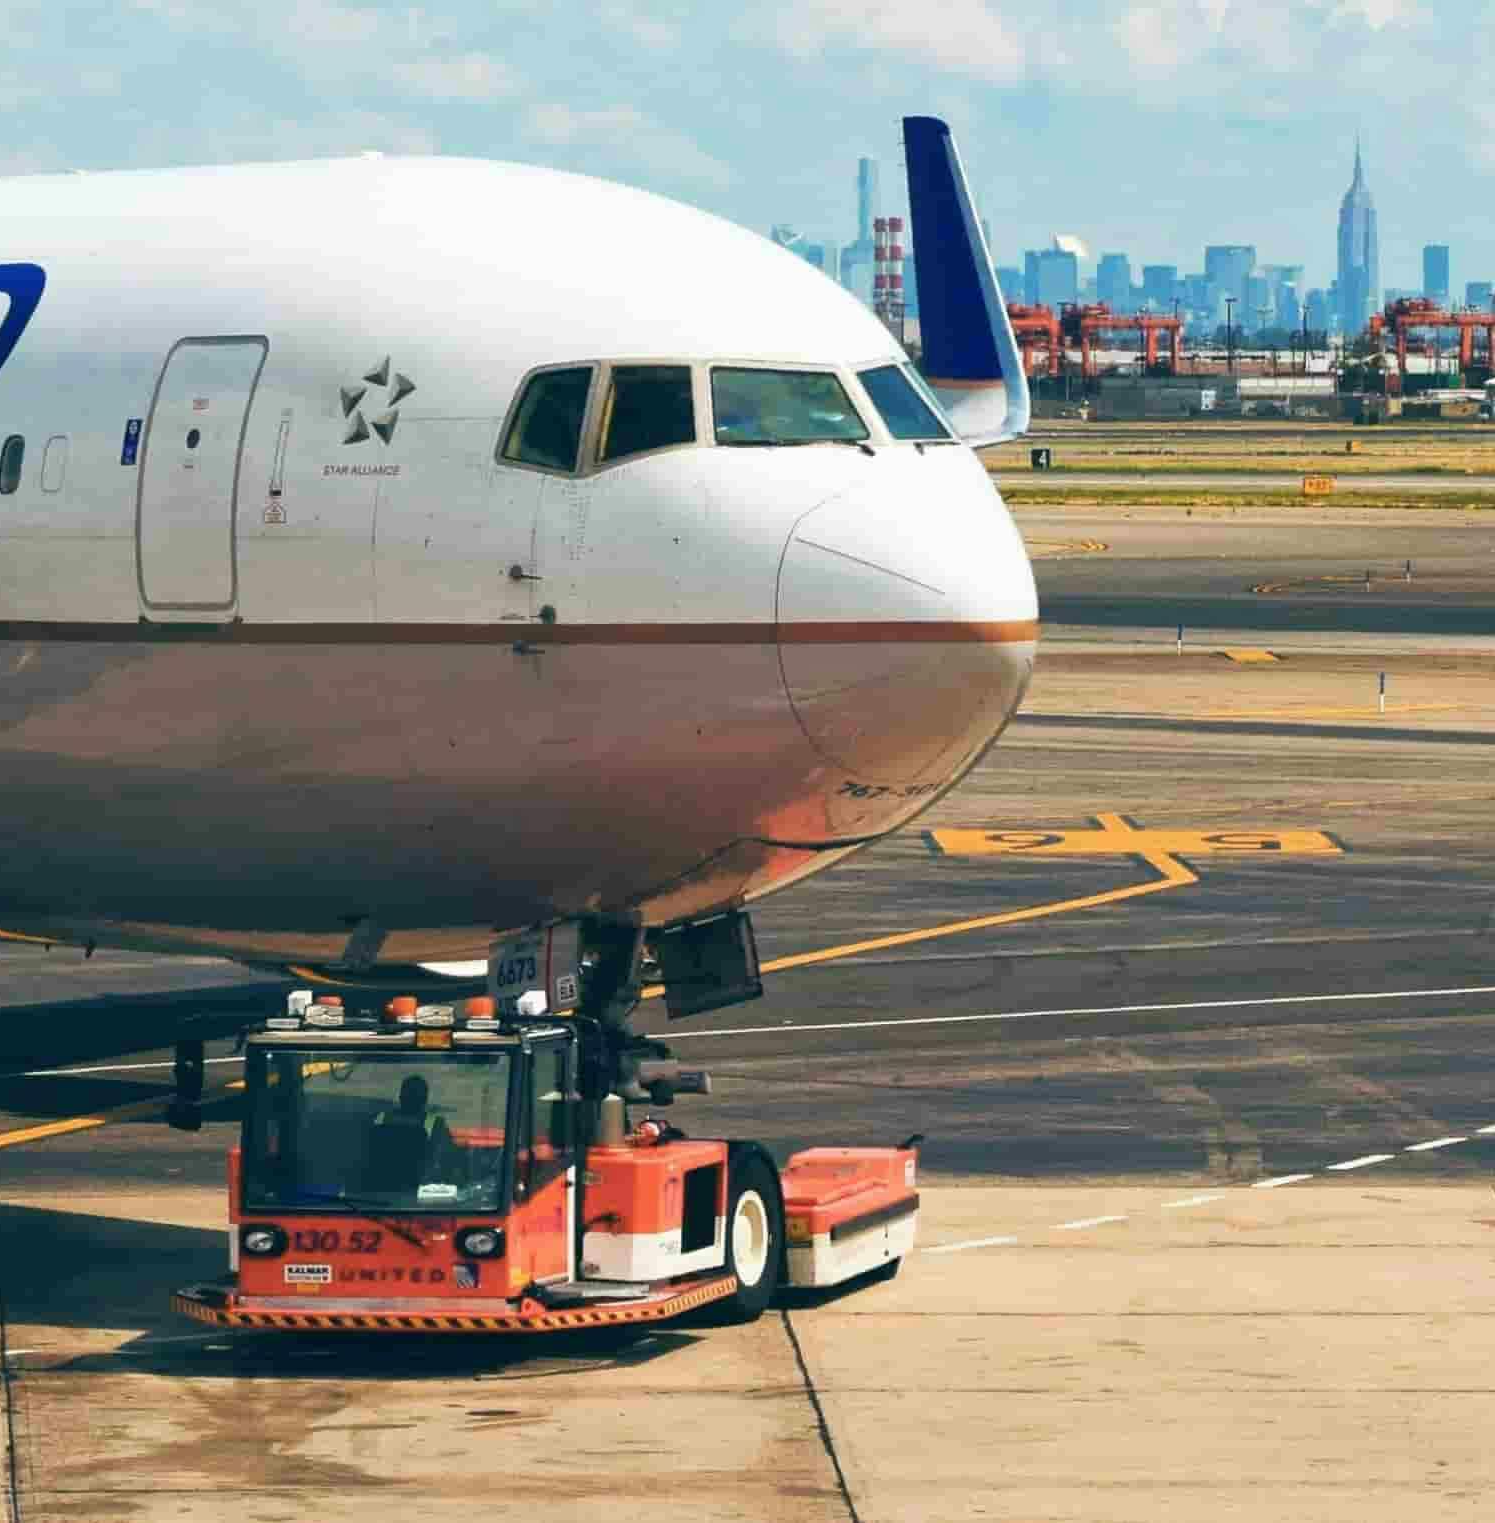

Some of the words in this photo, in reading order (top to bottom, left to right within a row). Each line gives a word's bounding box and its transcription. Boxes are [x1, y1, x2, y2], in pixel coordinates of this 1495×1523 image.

[323, 463, 349, 476] STAR
[351, 463, 401, 476] ALLIANCE
[338, 1267, 446, 1283] UNITED
